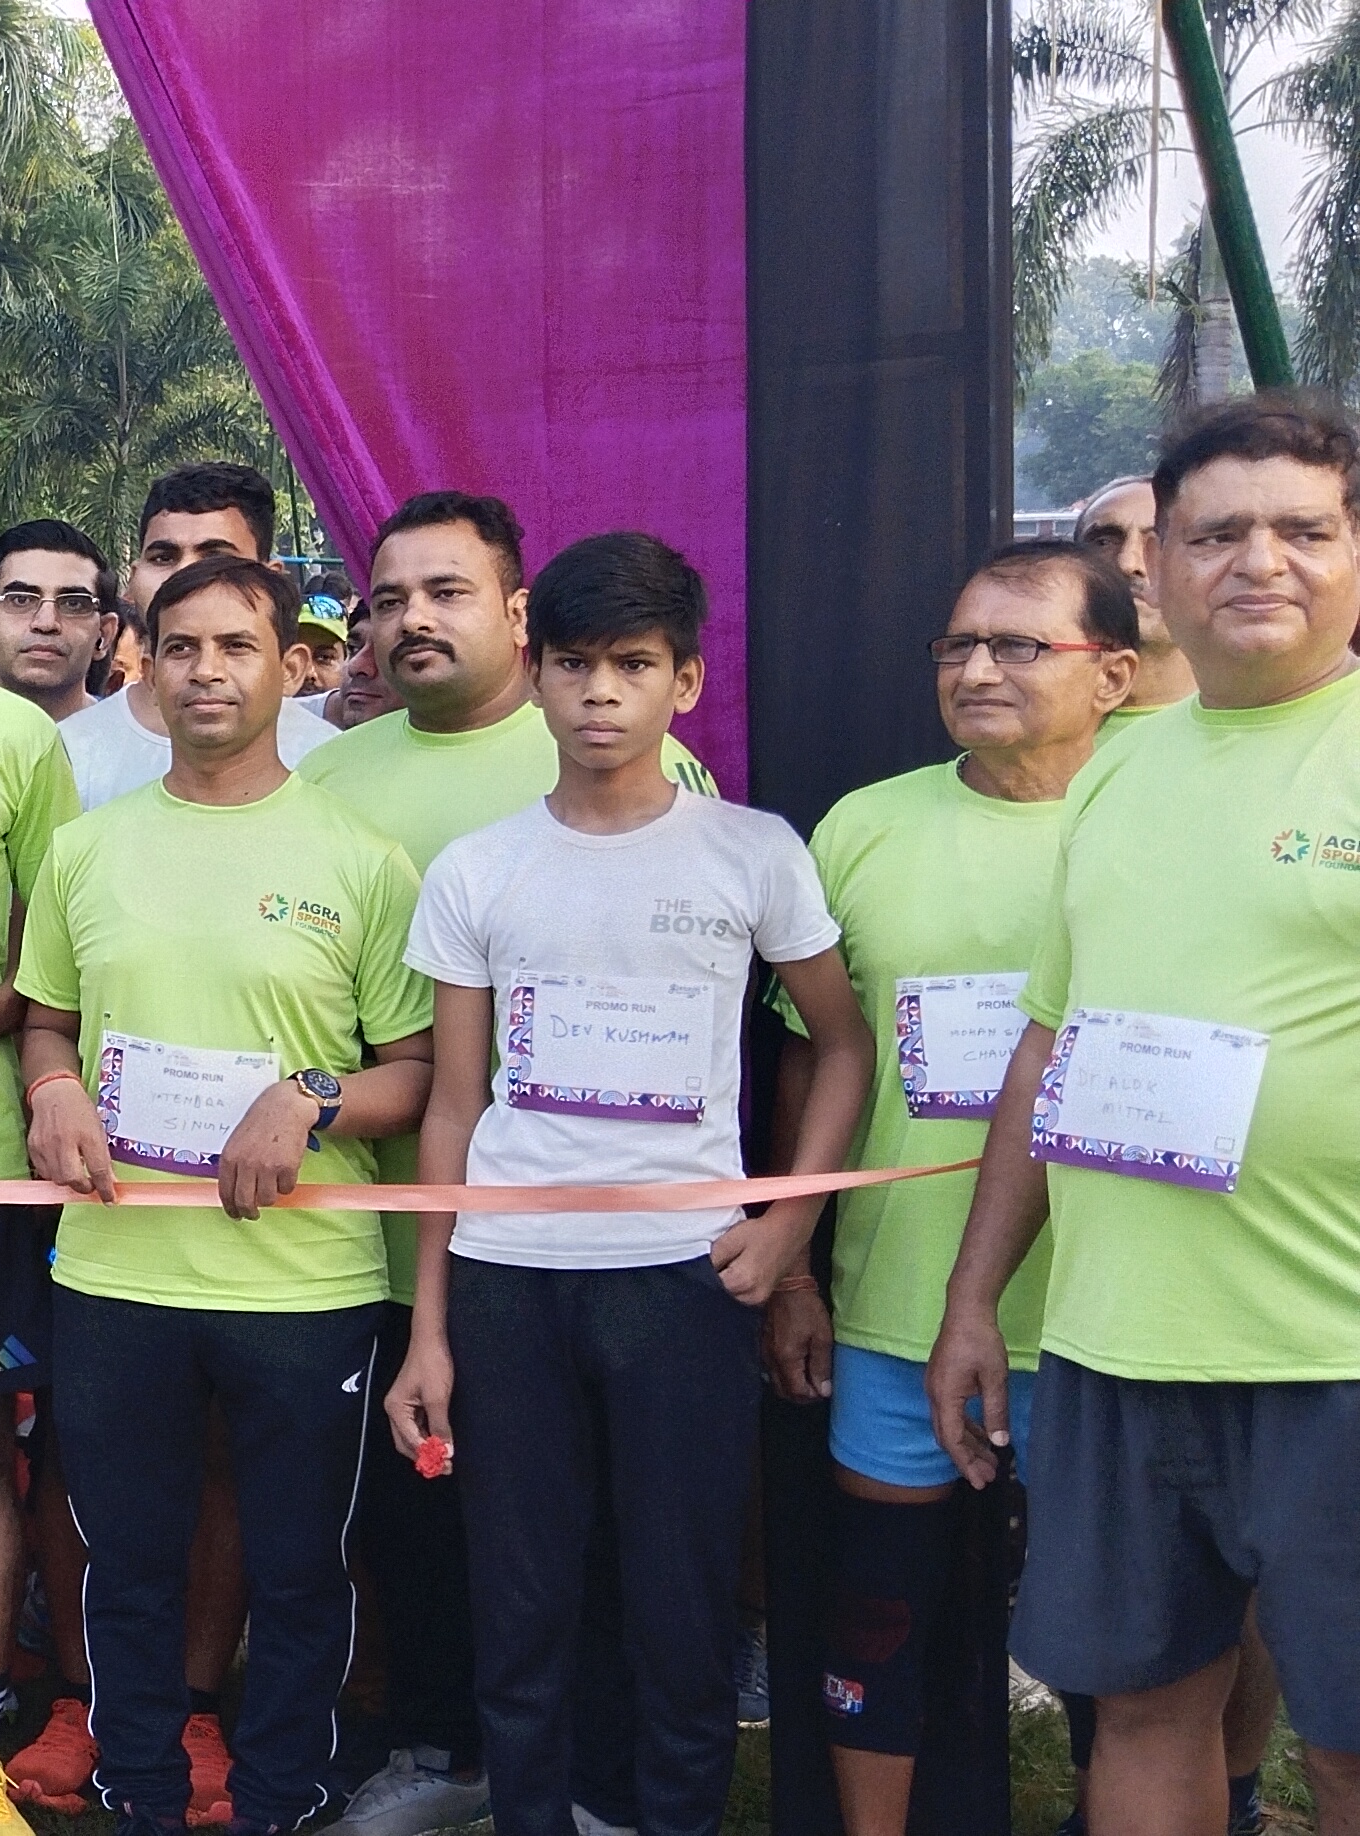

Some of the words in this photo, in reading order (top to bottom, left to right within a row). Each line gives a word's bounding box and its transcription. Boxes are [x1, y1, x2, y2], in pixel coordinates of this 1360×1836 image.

[1323, 835, 1360, 852] AG
[297, 900, 341, 924] AGRA
[654, 898, 693, 914] THE
[296, 911, 342, 935] SPORTS
[649, 914, 730, 938] BOYS
[585, 1000, 629, 1012] PROMO
[631, 1001, 657, 1014] RUN
[1118, 1040, 1160, 1056] PROMO
[1163, 1046, 1192, 1061] RUN
[163, 1066, 200, 1081] PROMO
[202, 1072, 224, 1083] RUN
